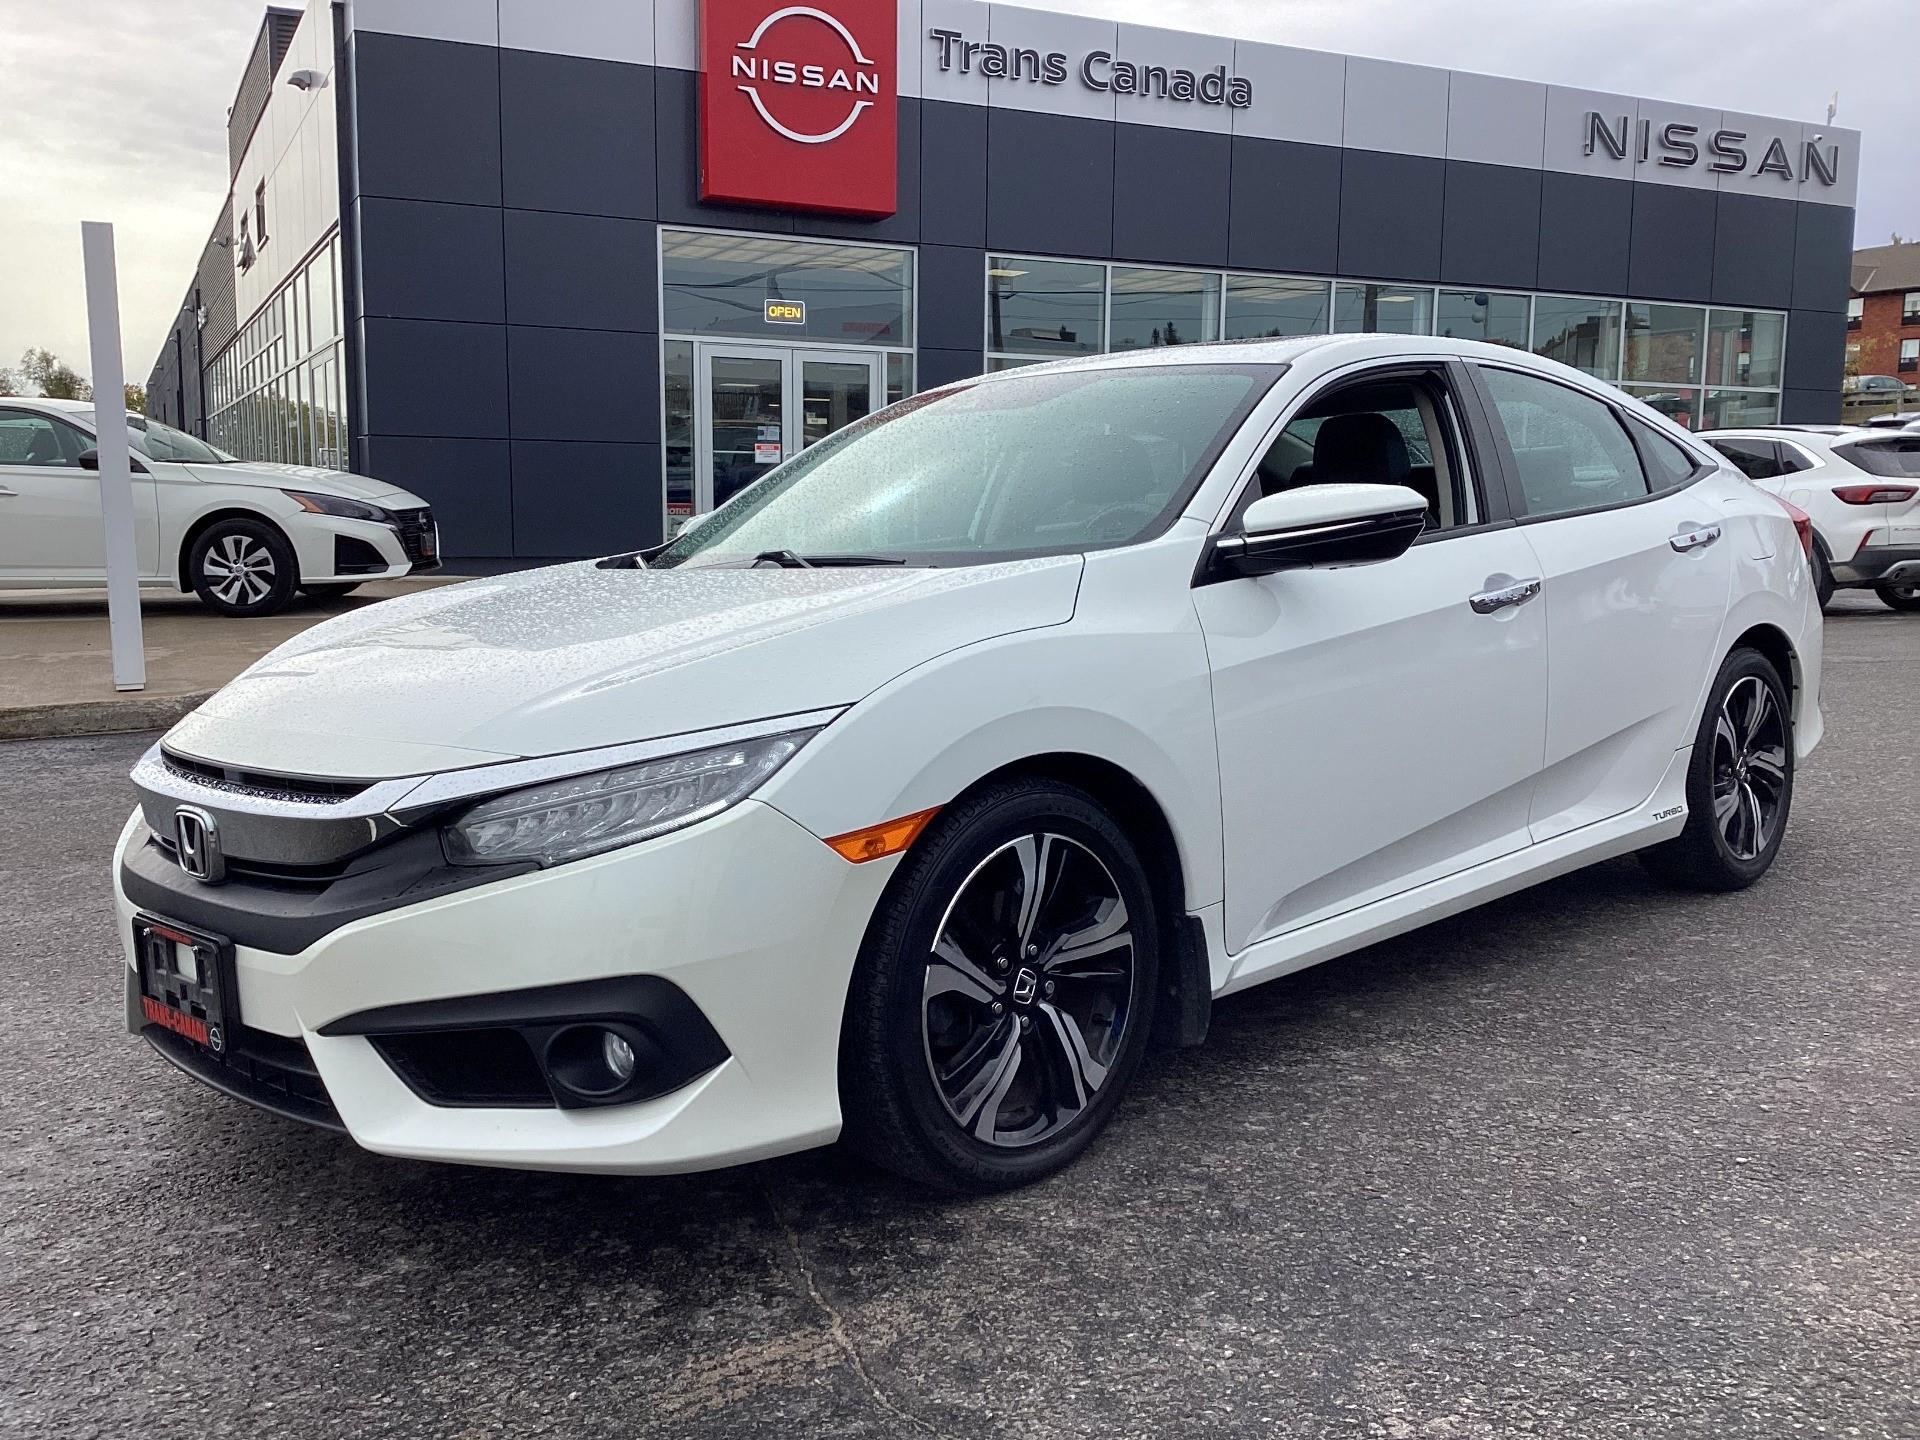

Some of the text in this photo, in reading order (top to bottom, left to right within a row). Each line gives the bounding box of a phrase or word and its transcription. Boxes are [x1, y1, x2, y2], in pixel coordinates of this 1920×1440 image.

[731, 55, 879, 94] NISSAN
[930, 28, 1253, 108] Trans Canada
[1584, 111, 1840, 186] NISSAN
[768, 306, 801, 318] OPEN
[667, 507, 691, 515] OTICE
[1652, 805, 1683, 821] TURBO
